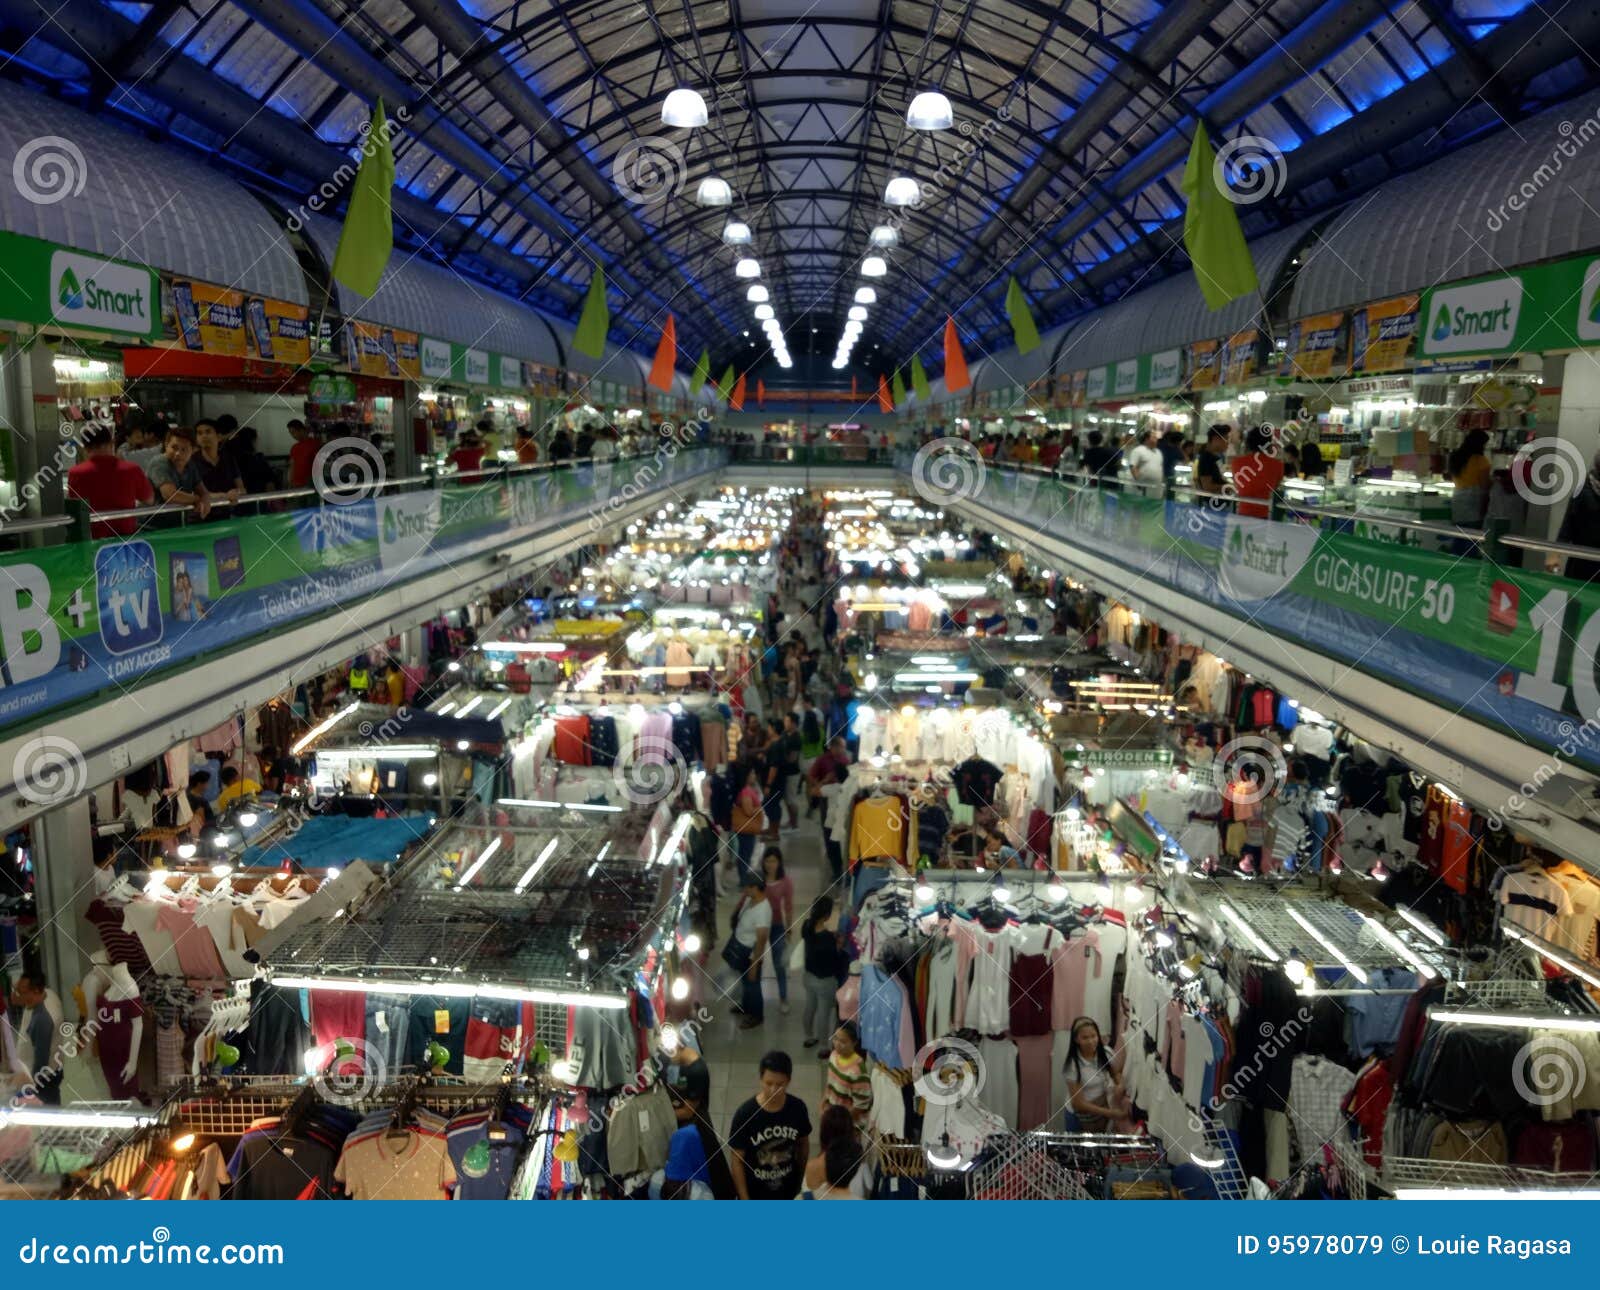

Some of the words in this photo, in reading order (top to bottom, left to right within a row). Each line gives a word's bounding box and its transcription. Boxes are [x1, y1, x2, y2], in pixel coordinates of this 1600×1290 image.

[86, 278, 146, 319] Smart
[1453, 299, 1512, 336] Smart
[1244, 532, 1288, 577] Smart
[1314, 552, 1416, 613] GIGASURF
[1419, 580, 1454, 625] 50
[108, 584, 150, 638] tv
[115, 657, 134, 677] DAY
[136, 645, 172, 668] ACCESS
[750, 1126, 799, 1146] LACOSTE
